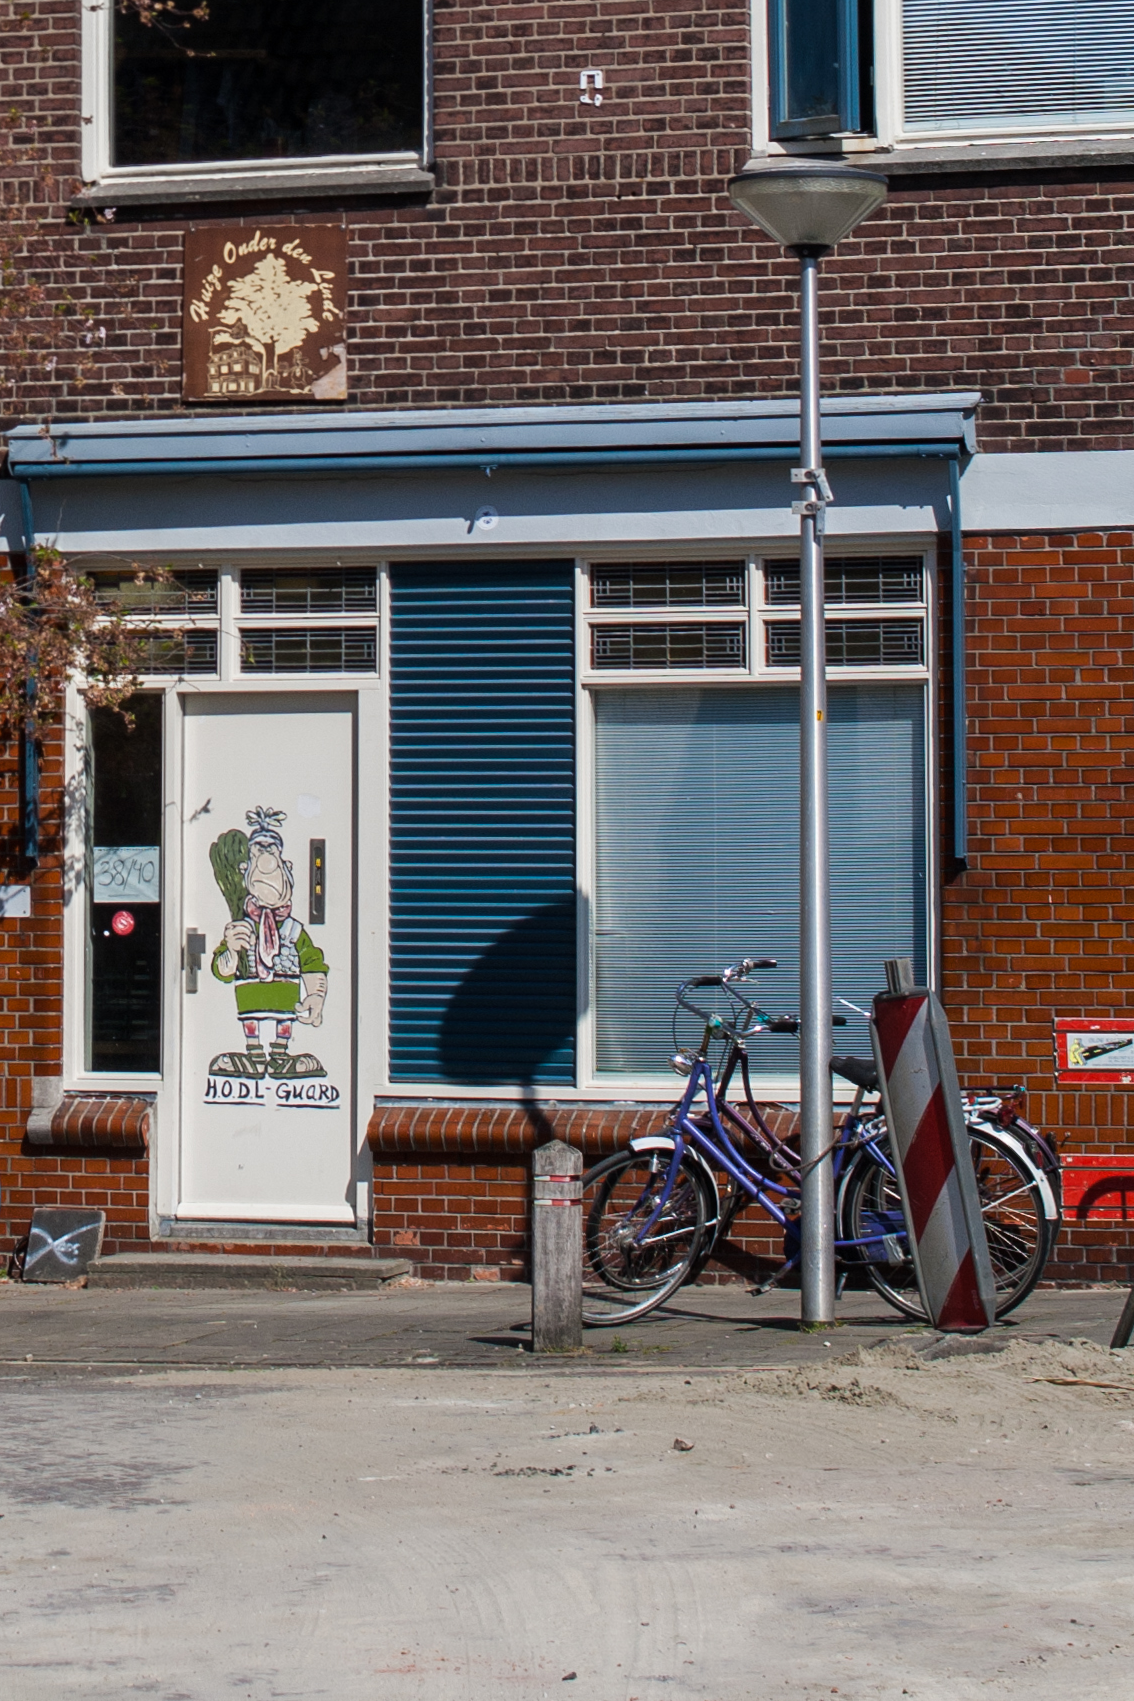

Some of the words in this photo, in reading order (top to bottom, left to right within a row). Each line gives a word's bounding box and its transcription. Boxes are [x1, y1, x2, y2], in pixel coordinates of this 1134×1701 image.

[189, 264, 223, 323] Huize
[223, 230, 277, 264] Onder
[282, 238, 313, 265] den
[310, 268, 340, 322] Linde
[98, 859, 156, 891] 38/40
